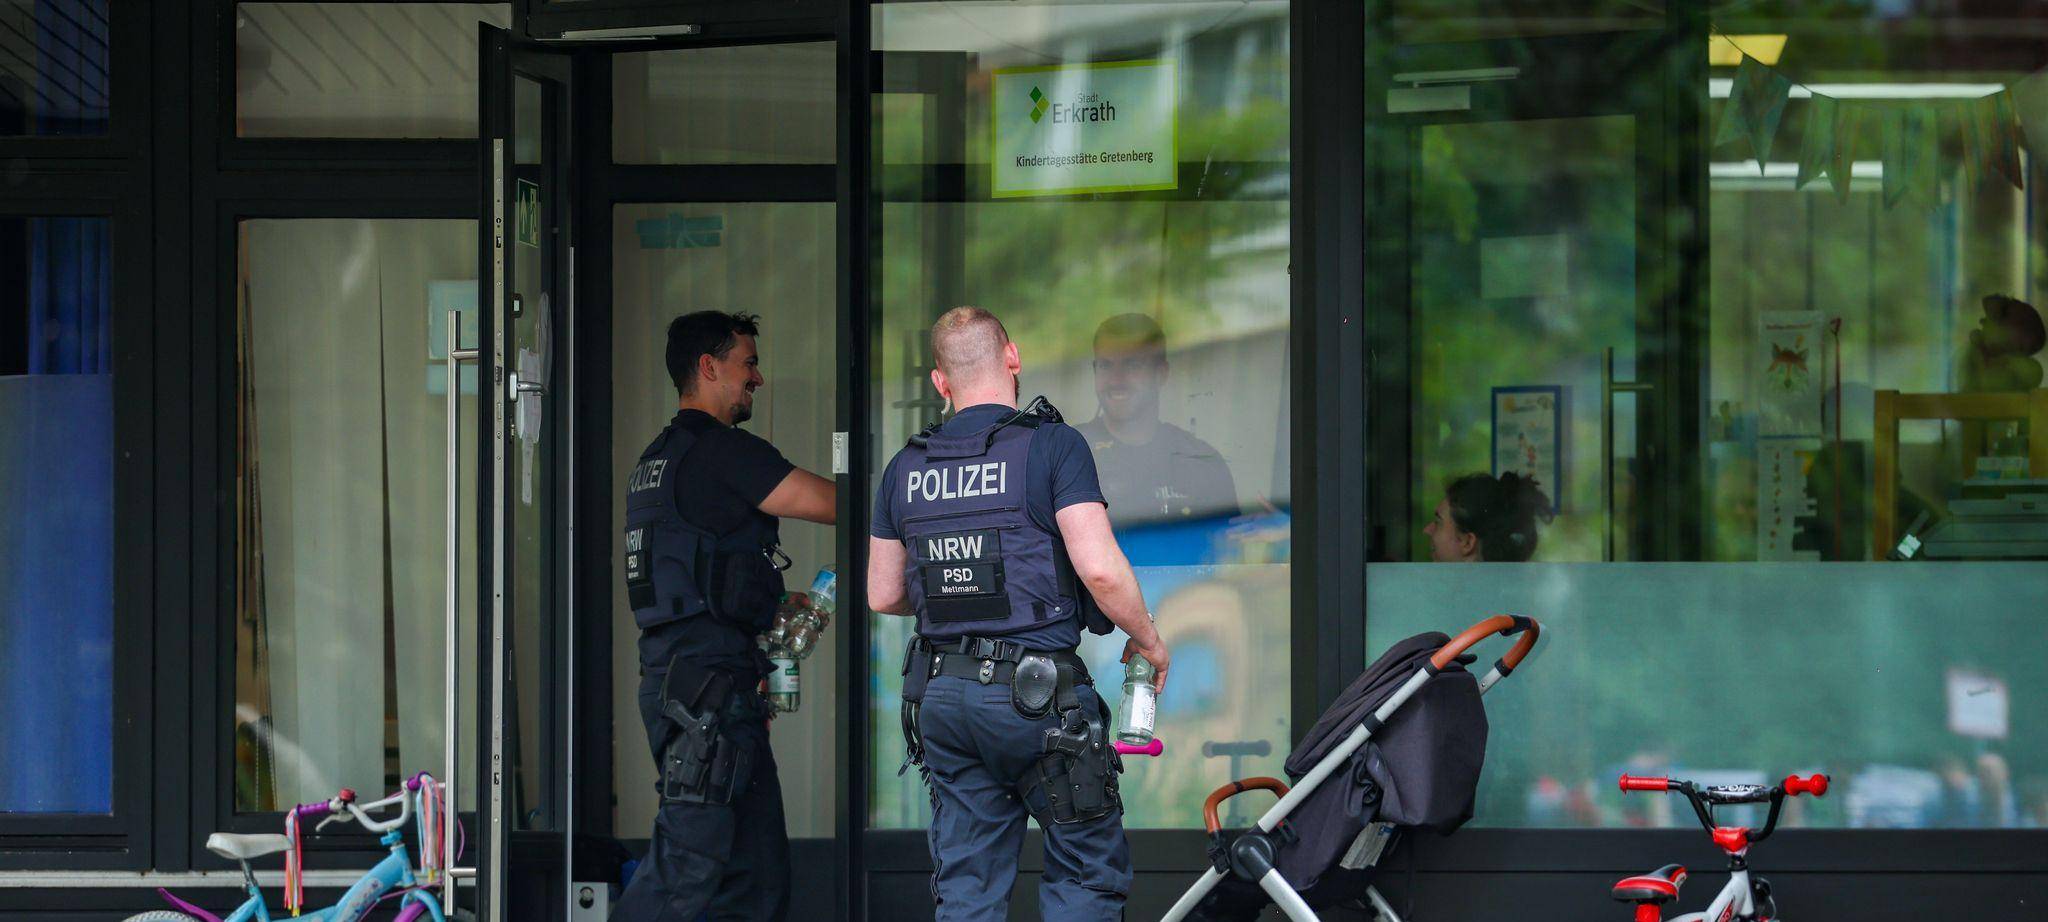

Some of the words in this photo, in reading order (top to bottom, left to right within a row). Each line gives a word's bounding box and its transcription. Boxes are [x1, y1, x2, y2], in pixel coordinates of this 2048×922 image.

[1078, 93, 1099, 103] Stadt
[1052, 101, 1116, 124] Erkrath
[1016, 152, 1098, 168] Kindertagesstätte
[1100, 150, 1154, 164] Gretenberg
[907, 461, 1007, 503] POLIZEI
[928, 535, 983, 562] NRW
[943, 567, 973, 583] PSD
[941, 584, 979, 594] Mettmann
